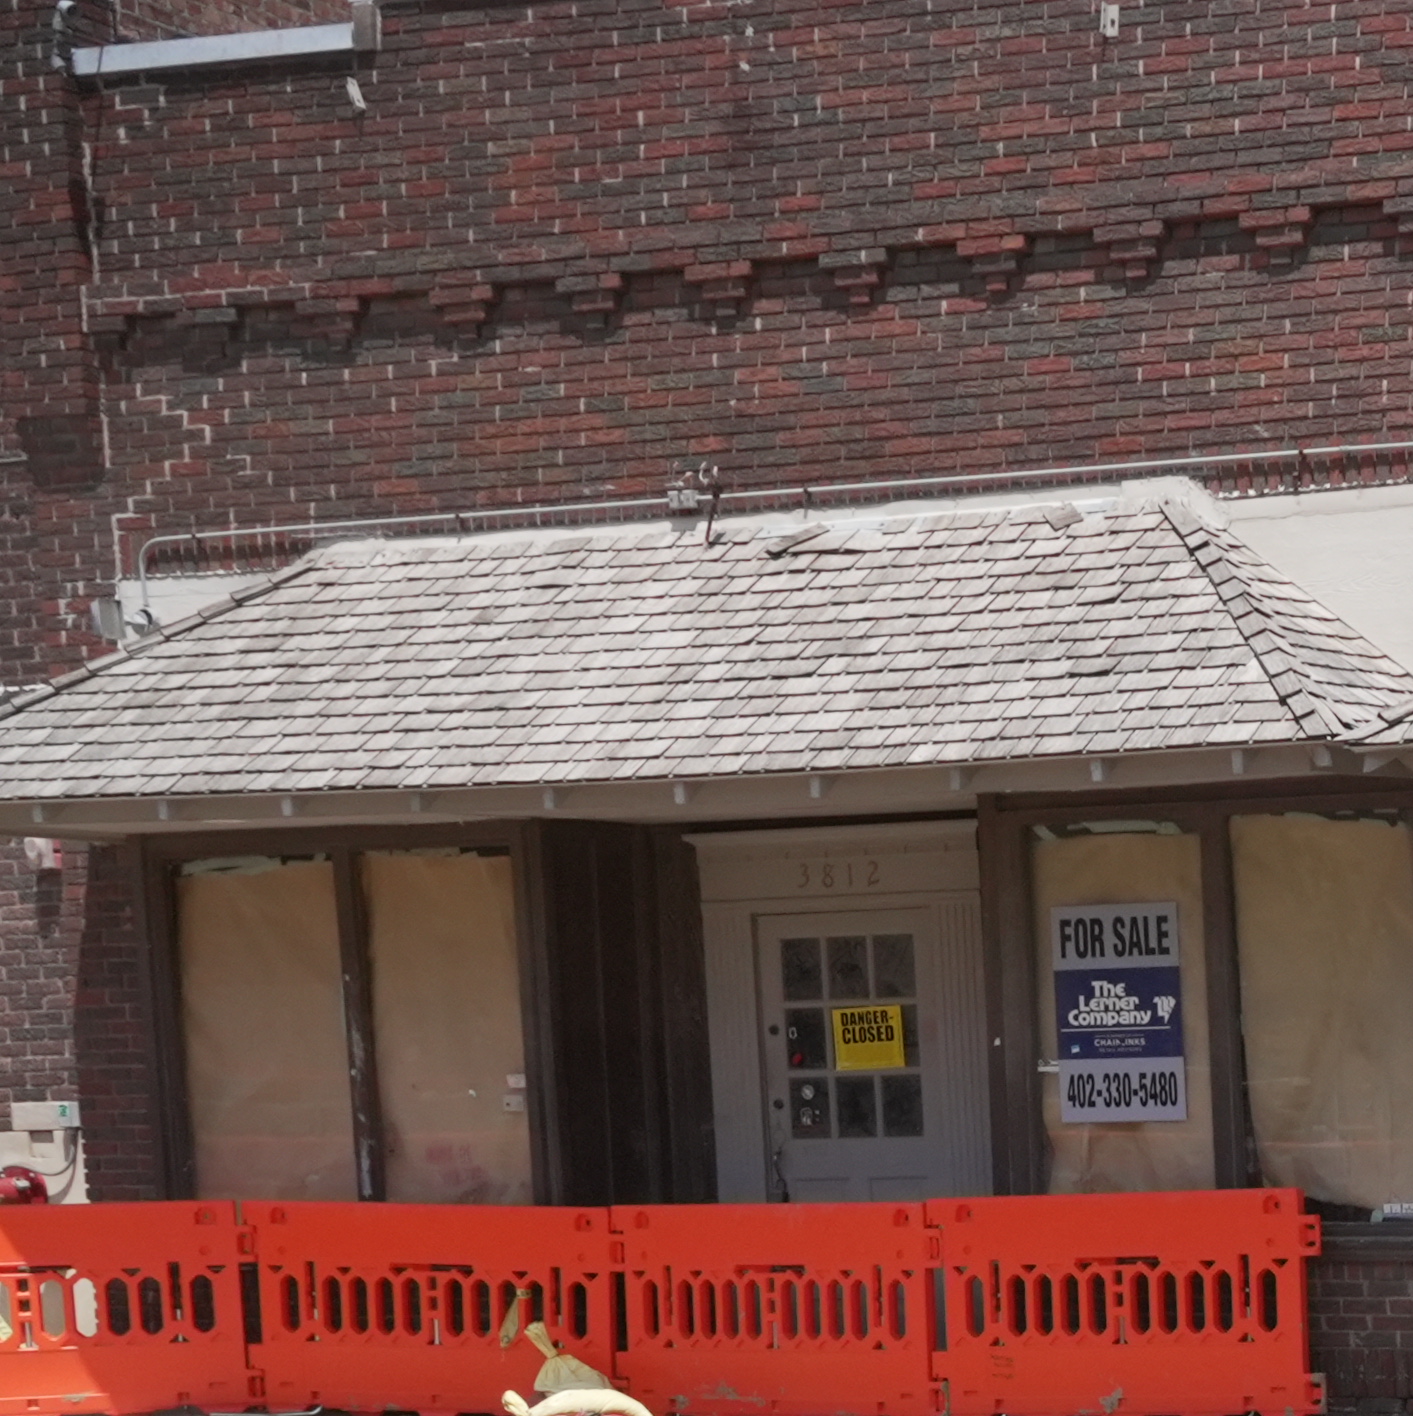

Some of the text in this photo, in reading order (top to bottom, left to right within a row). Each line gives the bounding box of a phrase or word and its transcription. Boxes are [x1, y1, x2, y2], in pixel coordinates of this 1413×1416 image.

[797, 860, 880, 888] 3812
[1059, 915, 1171, 959] FOR SALE
[1091, 980, 1126, 997] The
[1078, 995, 1139, 1012] Lerner
[1068, 1009, 1152, 1027] Company
[842, 1025, 895, 1044] CLOSED
[1067, 1071, 1178, 1109] 402-330-5480
